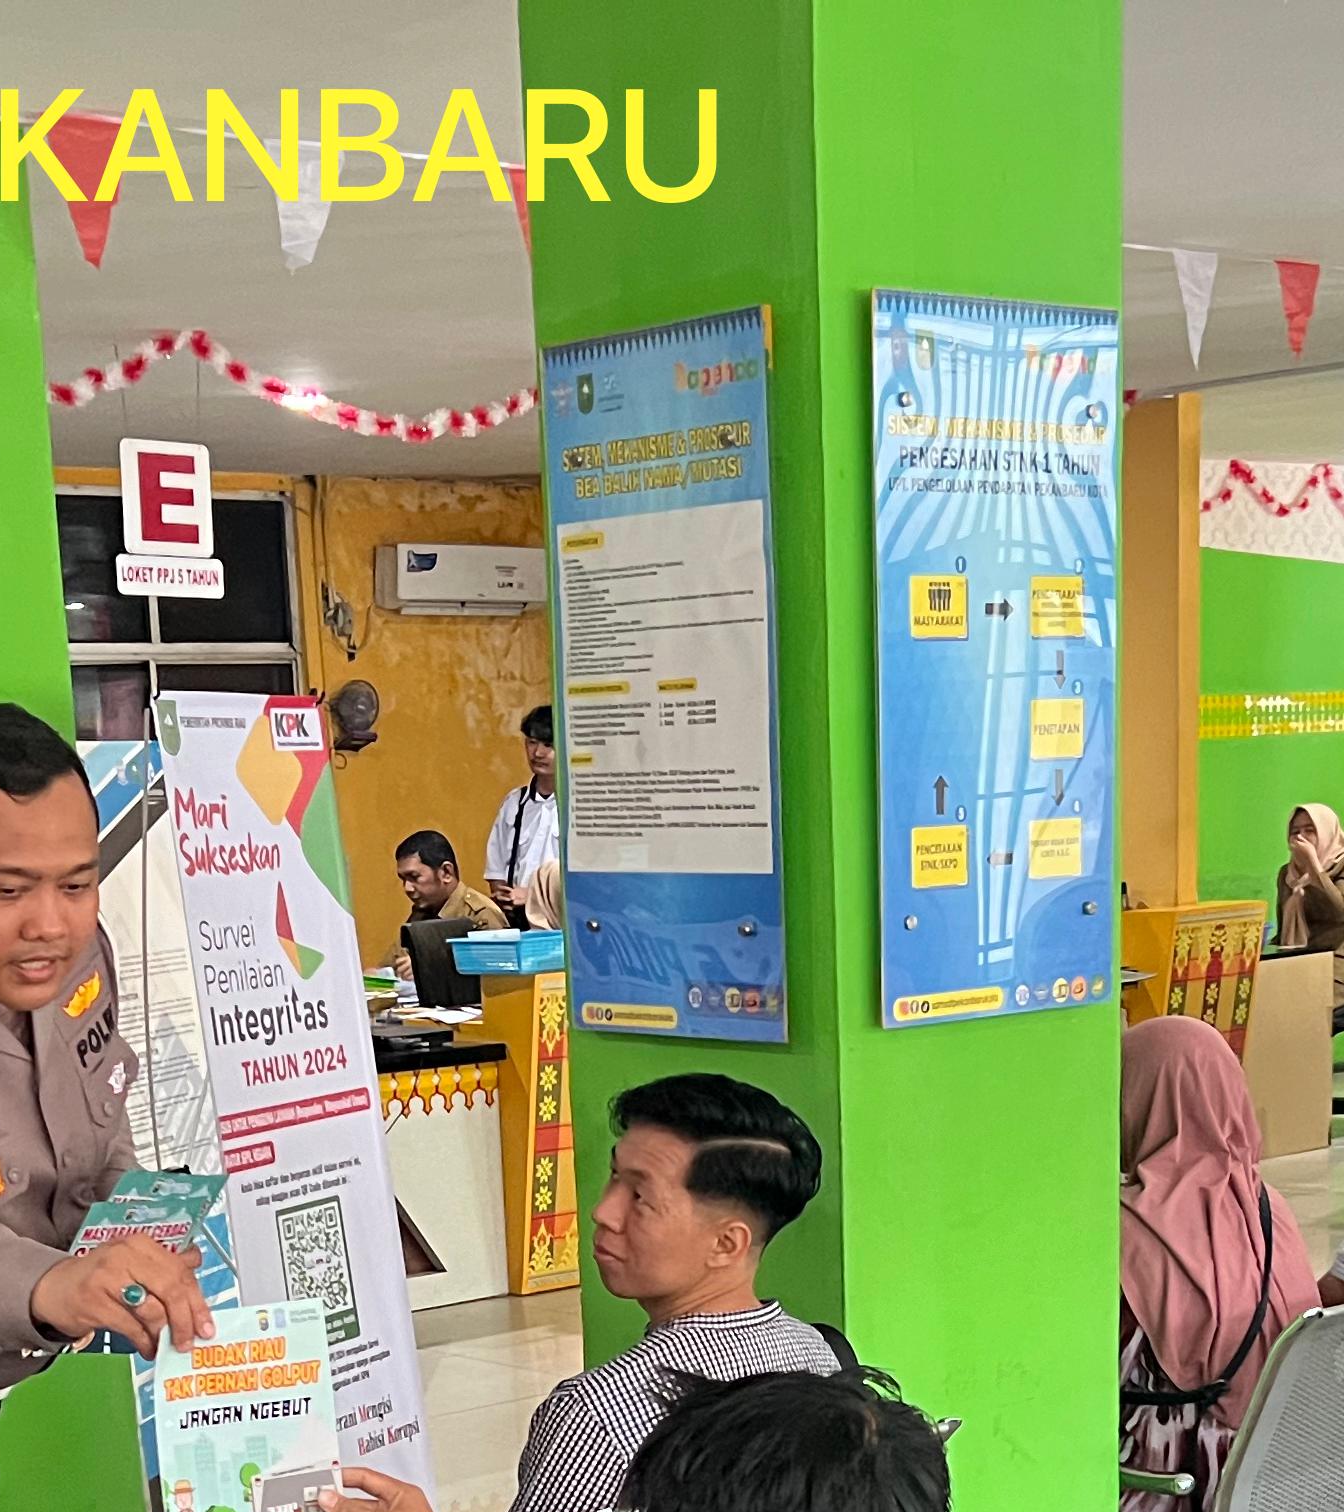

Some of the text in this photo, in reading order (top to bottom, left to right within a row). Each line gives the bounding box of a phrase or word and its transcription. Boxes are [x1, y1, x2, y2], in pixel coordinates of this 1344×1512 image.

[899, 446, 1100, 476] PENGESAHAN STNK 1 TAHUN
[137, 452, 199, 544] E
[575, 476, 600, 499] BEA
[121, 566, 153, 582] LOKET
[178, 568, 184, 584] 5
[187, 569, 219, 586] TAHUN
[913, 615, 964, 627] MASYARAKAT
[274, 712, 309, 737] KPK
[174, 786, 229, 831] Mari
[179, 832, 281, 877] Sukseskan
[199, 916, 256, 951] Survei
[204, 958, 285, 995] Penilaian
[210, 985, 329, 1046] Integritas
[76, 1002, 116, 1068] POLR
[241, 1044, 347, 1086] TAHUN 2024
[191, 1335, 287, 1371] BUDAK RIAU
[163, 1378, 192, 1402] TAK
[195, 1369, 258, 1398] PERNAH
[259, 1359, 321, 1390] GOLPUT
[179, 1397, 312, 1429] JANGAN NGEBUT
[336, 1394, 393, 1432] erani Mengisi
[386, 1415, 420, 1443] Korupsi
